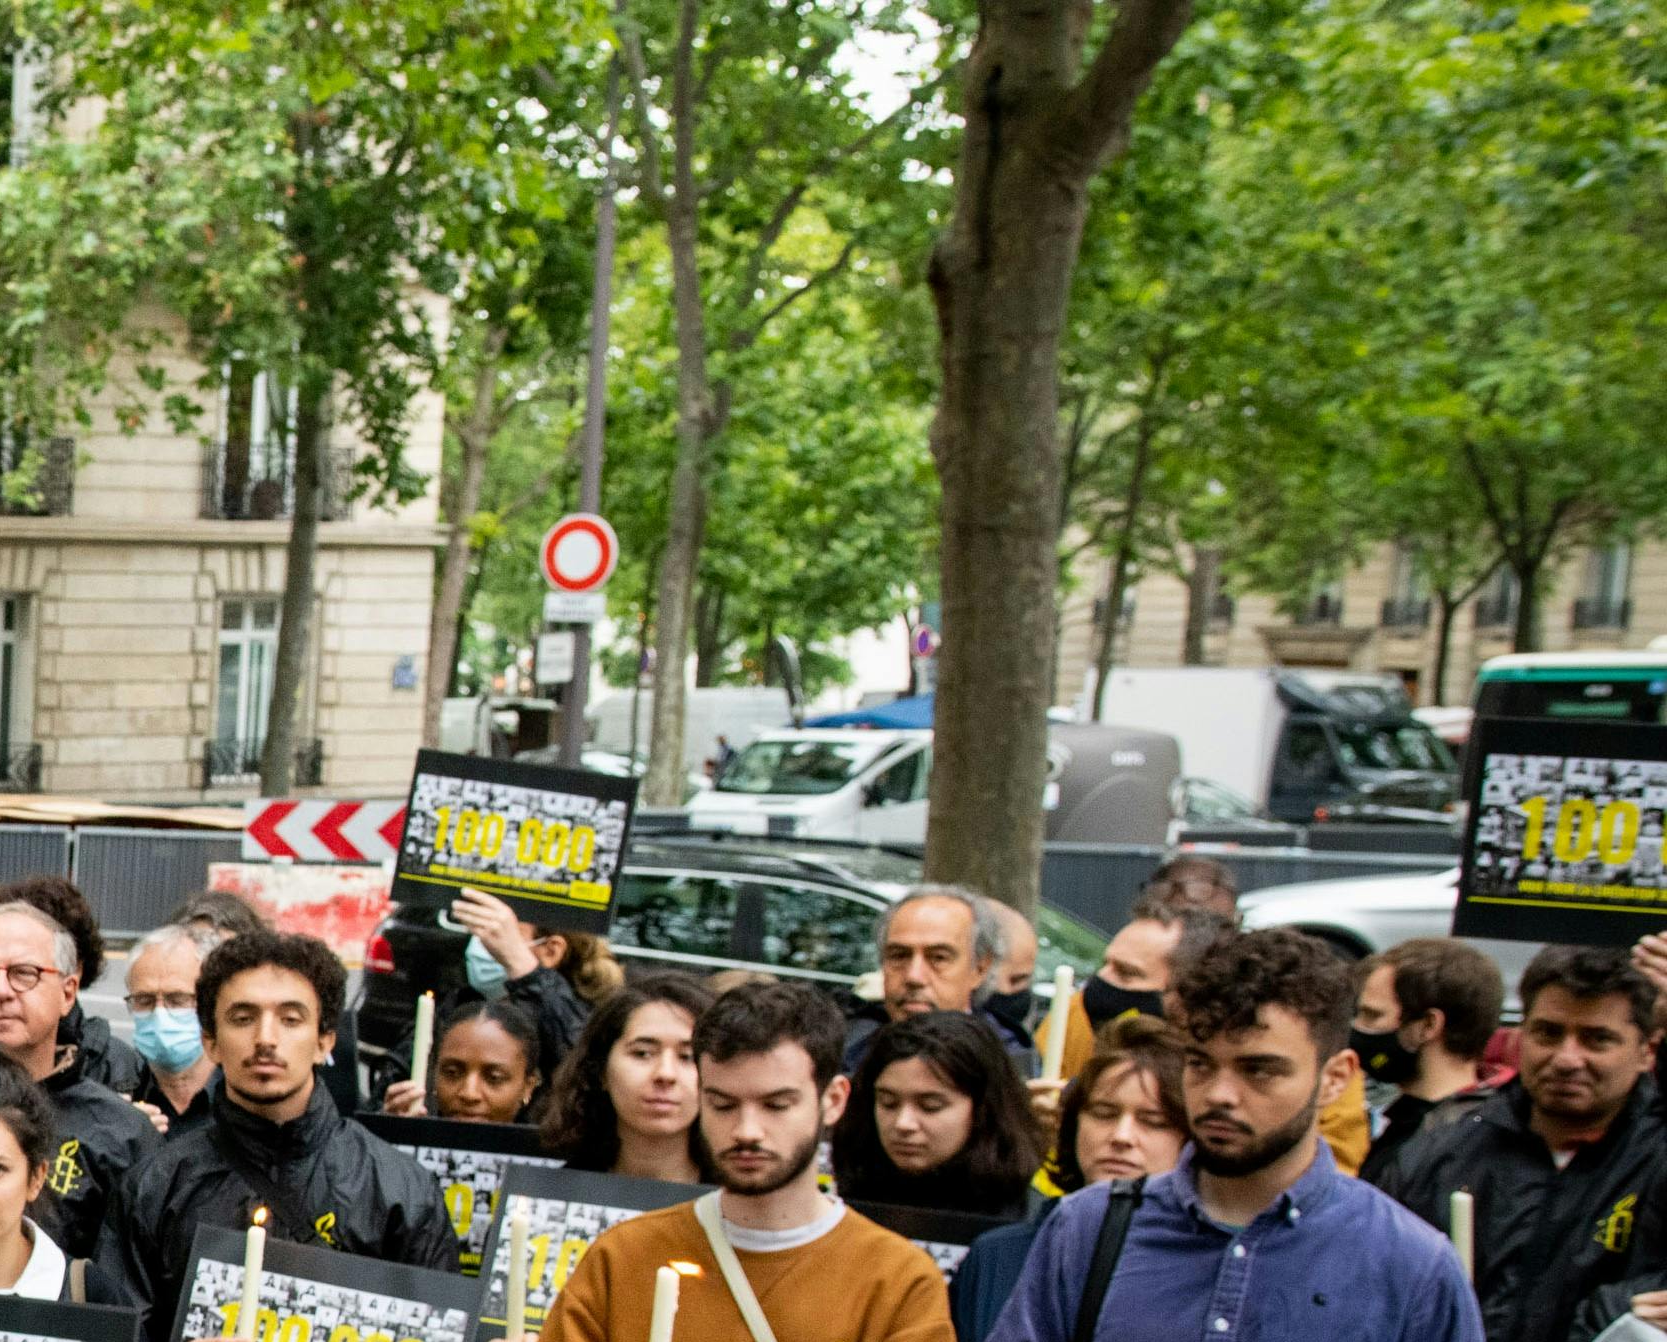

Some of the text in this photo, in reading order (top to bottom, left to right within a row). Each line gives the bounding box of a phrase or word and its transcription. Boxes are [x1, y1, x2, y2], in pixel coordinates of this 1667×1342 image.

[434, 805, 596, 873] 100 000
[1520, 795, 1641, 865] 100
